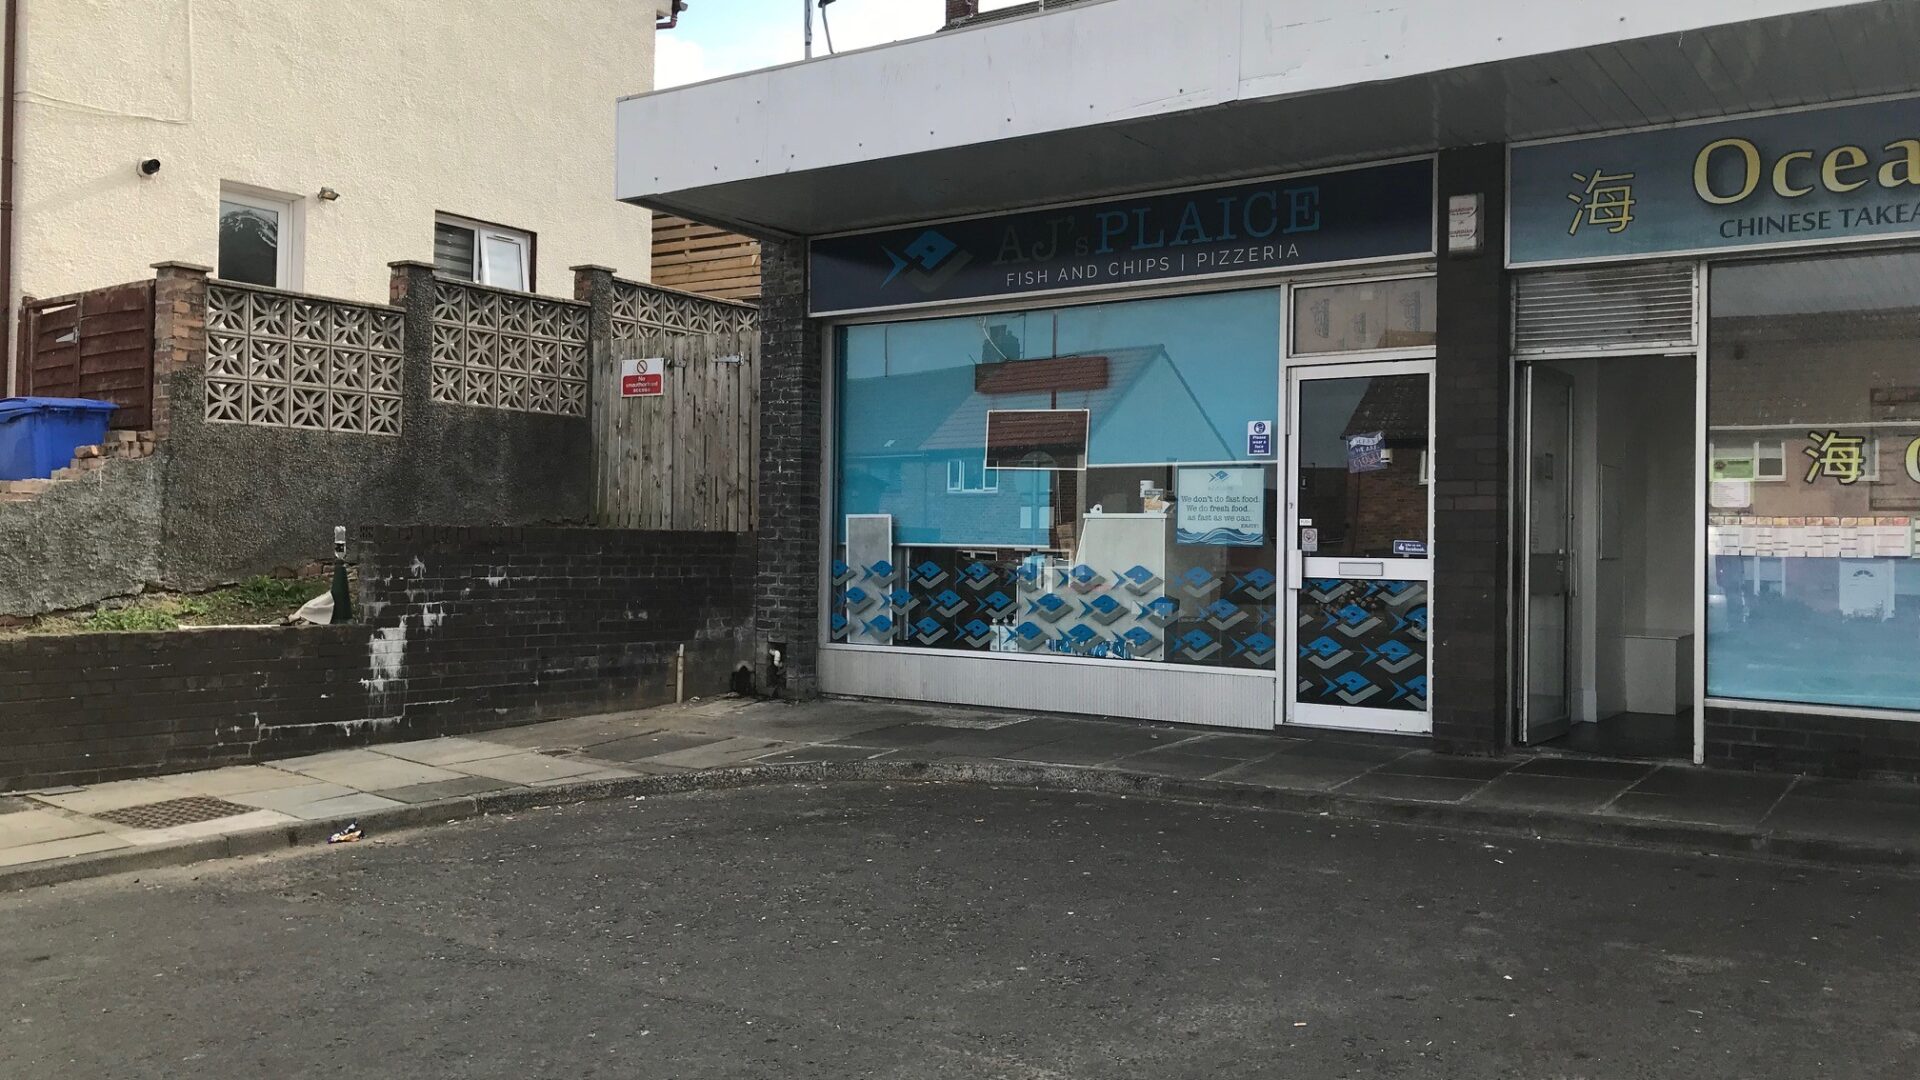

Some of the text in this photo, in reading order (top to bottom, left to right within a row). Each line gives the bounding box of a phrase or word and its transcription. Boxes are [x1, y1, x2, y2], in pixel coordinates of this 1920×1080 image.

[1095, 186, 1320, 254] PLAICE
[1566, 169, 1636, 237] 海
[1719, 210, 1831, 239] CHINESE
[1006, 269, 1048, 287] FISH
[1057, 264, 1098, 282] AND
[1108, 256, 1170, 276] CHIPS
[1197, 243, 1299, 268] PIZZERIA
[1803, 430, 1866, 486] 海
[1181, 495, 1192, 503] We
[1193, 495, 1213, 503] don't
[1214, 495, 1224, 503] do
[1225, 495, 1240, 503] fast
[1197, 513, 1212, 521] fast
